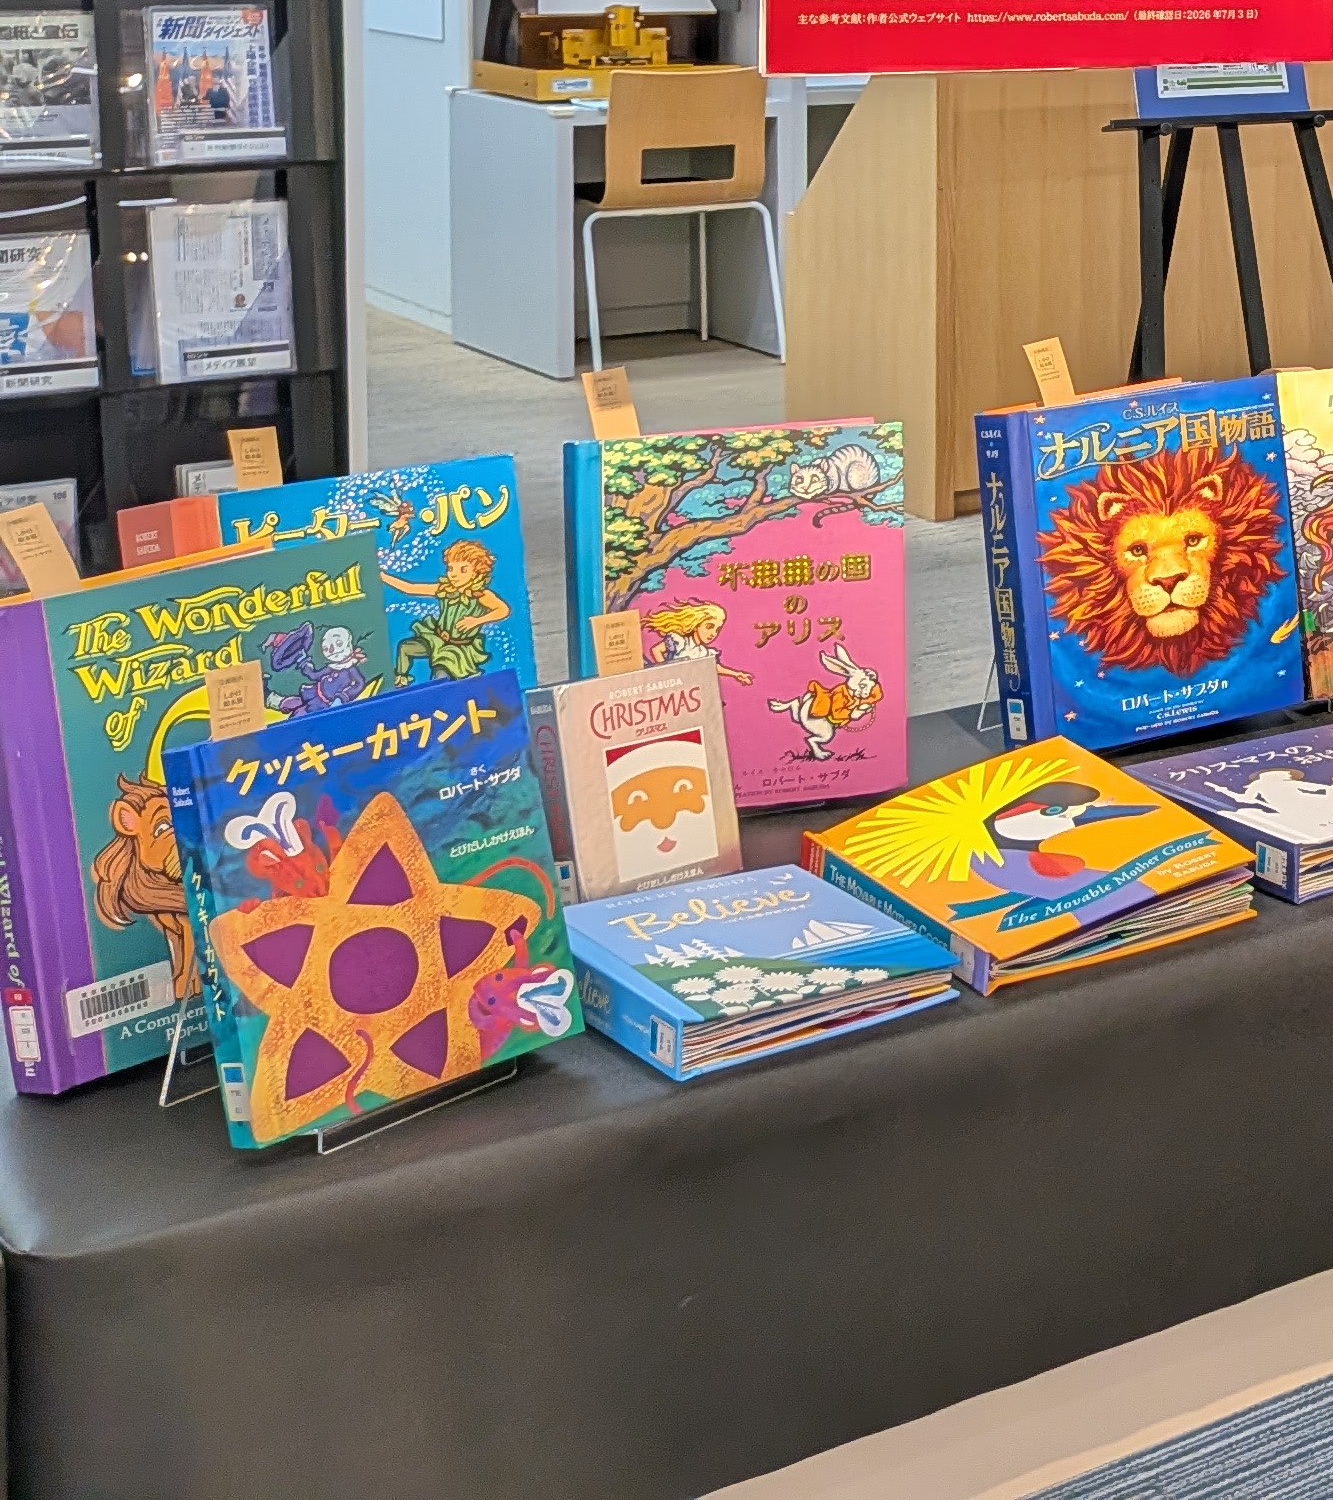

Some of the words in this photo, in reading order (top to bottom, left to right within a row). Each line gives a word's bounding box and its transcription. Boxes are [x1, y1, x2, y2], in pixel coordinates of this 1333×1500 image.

[967, 10, 1130, 23] https://www.robertsabuda.com/
[1037, 408, 1277, 478] ナルニア国物語
[717, 553, 873, 592] 不思議の国
[63, 612, 131, 660] The
[131, 562, 366, 643] Wonderful
[753, 616, 847, 648] アリス
[69, 634, 250, 702] Wizard
[609, 684, 644, 700] ROBERT
[649, 677, 683, 693] SABUDA
[104, 696, 147, 750] of
[589, 686, 701, 739] CHRISTMAS
[227, 699, 497, 797] クッキーカウント
[1168, 744, 1314, 781] クリスマスの
[439, 765, 522, 800] ロバート・サブダ
[763, 768, 851, 788] ロバート・サブダ
[449, 825, 535, 858] とびだししかけえほん
[830, 866, 847, 887] THE
[1004, 907, 1040, 927] The
[1046, 882, 1112, 915] Movable
[1113, 855, 1161, 884] Mother
[1163, 836, 1206, 857] Goose
[1156, 864, 1173, 877] by
[1175, 851, 1218, 871] ROBERT
[1173, 859, 1219, 879] SABUDA
[608, 889, 810, 941] Believe
[120, 1024, 132, 1040] A
